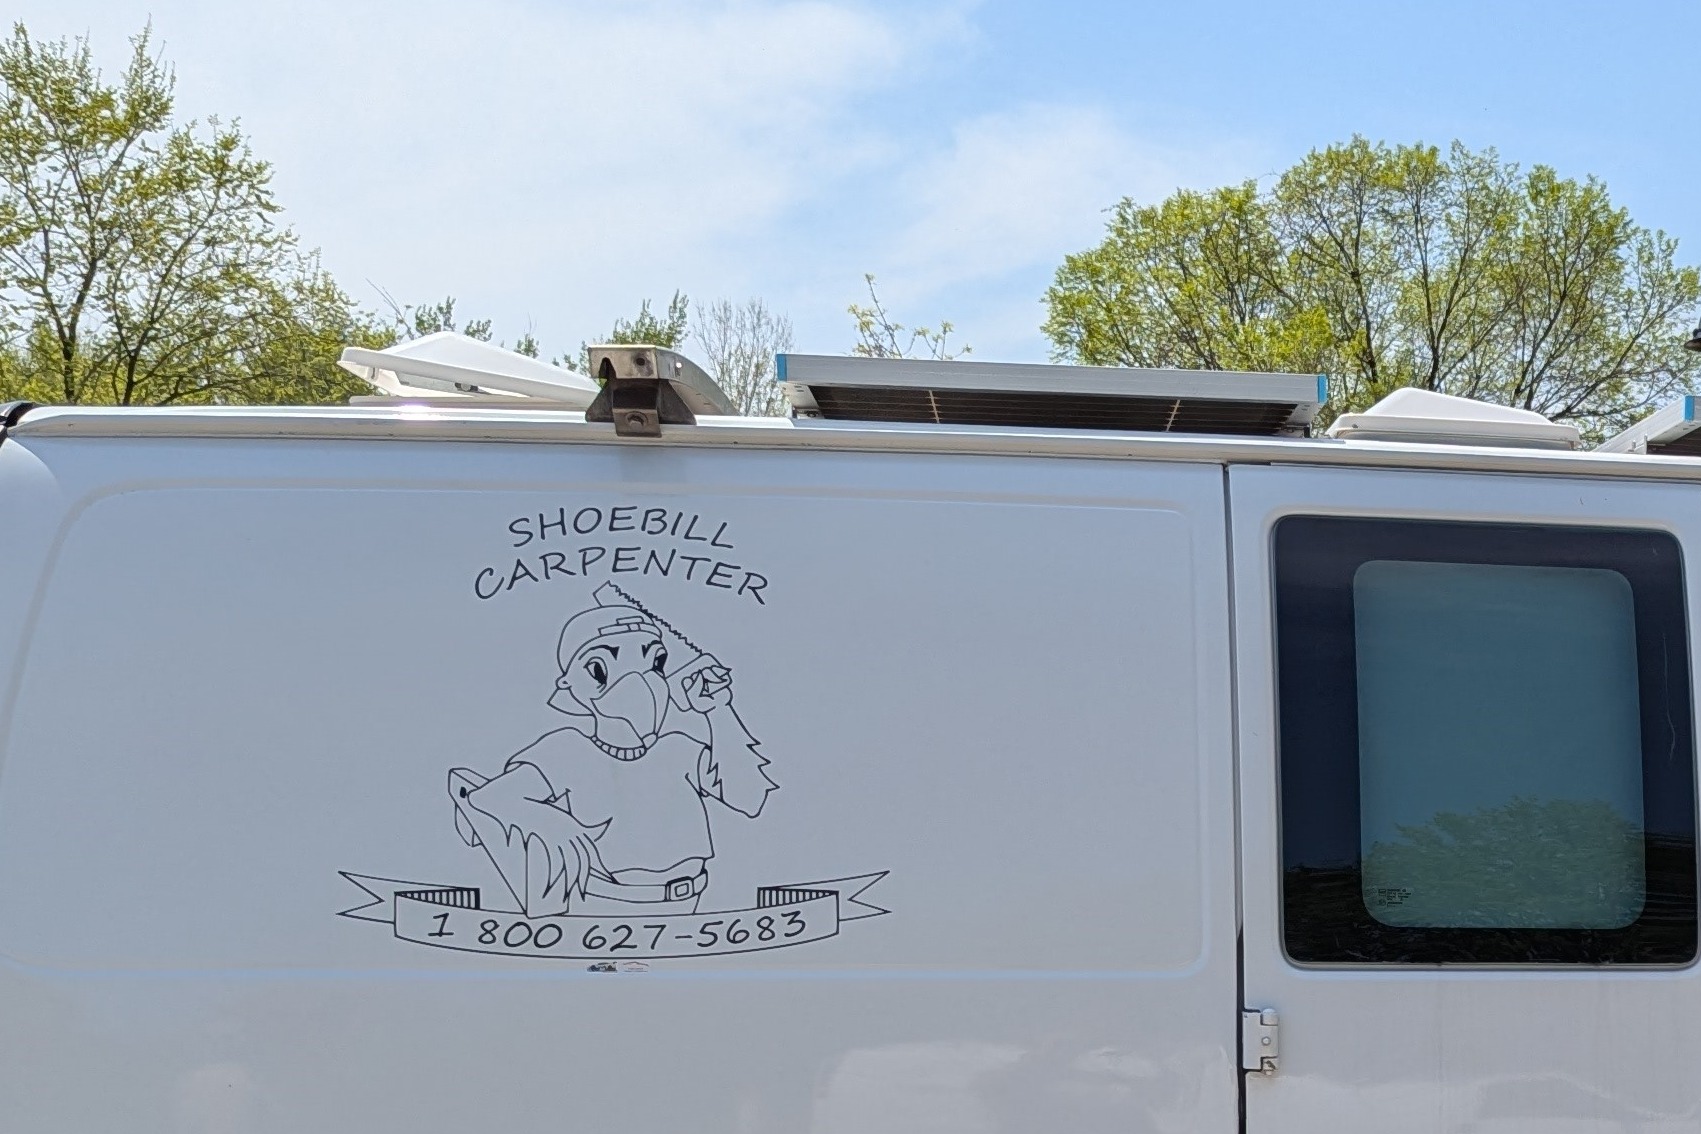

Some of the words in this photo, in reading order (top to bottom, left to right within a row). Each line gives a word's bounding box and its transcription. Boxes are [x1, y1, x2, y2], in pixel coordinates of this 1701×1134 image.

[508, 505, 734, 549] SHOEBILL
[474, 546, 768, 606] CARPENTER
[427, 912, 455, 938] 1
[477, 918, 563, 949] 800
[581, 910, 806, 953] 627-5683
